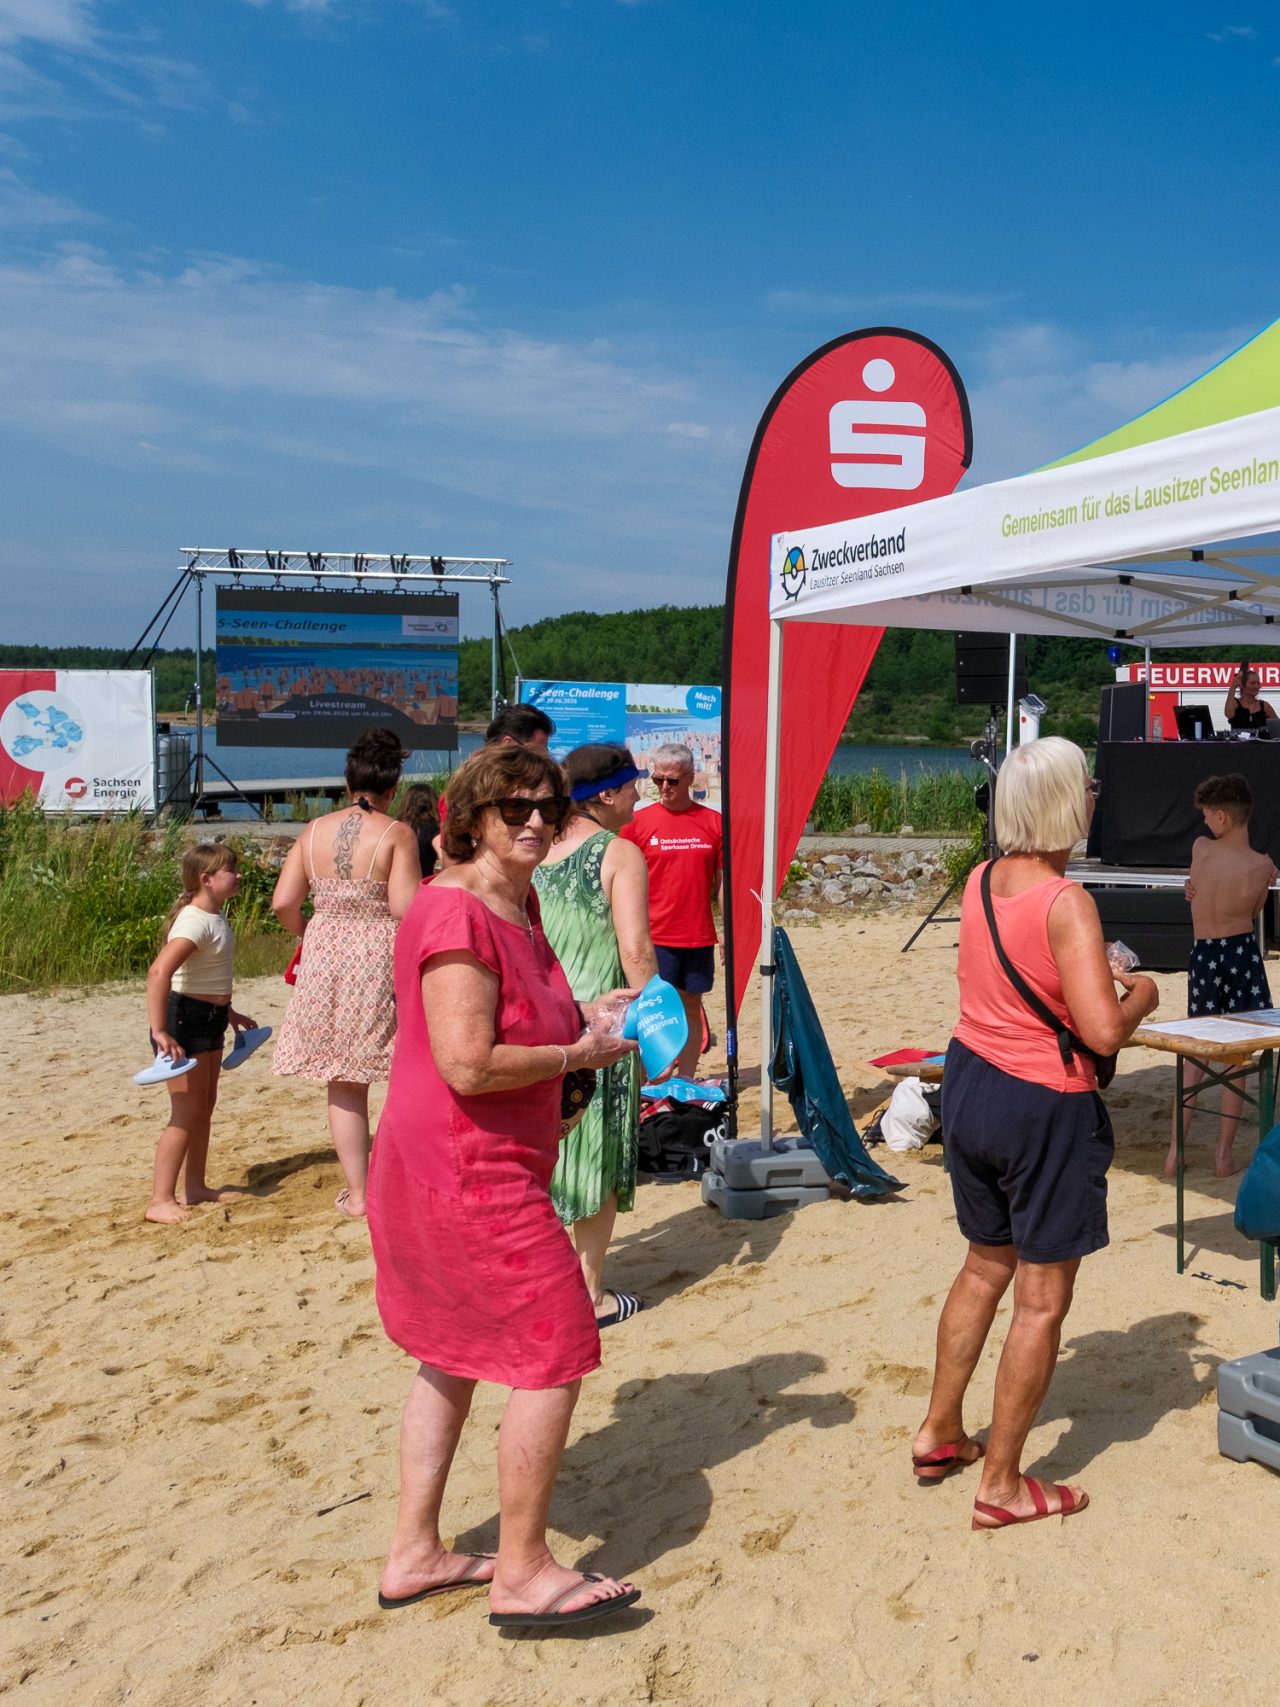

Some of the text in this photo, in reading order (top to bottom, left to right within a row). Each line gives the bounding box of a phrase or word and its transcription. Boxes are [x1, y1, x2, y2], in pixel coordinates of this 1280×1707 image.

[1001, 505, 1078, 538] Gemeinsam
[1081, 497, 1101, 523] für
[1104, 491, 1131, 517] das
[1134, 475, 1207, 511] Lausitzer
[811, 526, 906, 572] Zweckverband
[809, 560, 905, 590] Lausitzer Seenland Sachsen
[217, 617, 348, 633] 5-Seen-Challenge
[528, 687, 620, 700] 5-Seen-Challenge
[694, 691, 717, 704] Mach
[309, 700, 366, 709] Livestream
[696, 702, 712, 711] mit!
[93, 777, 141, 787] Sachsen
[93, 788, 138, 799] Energie
